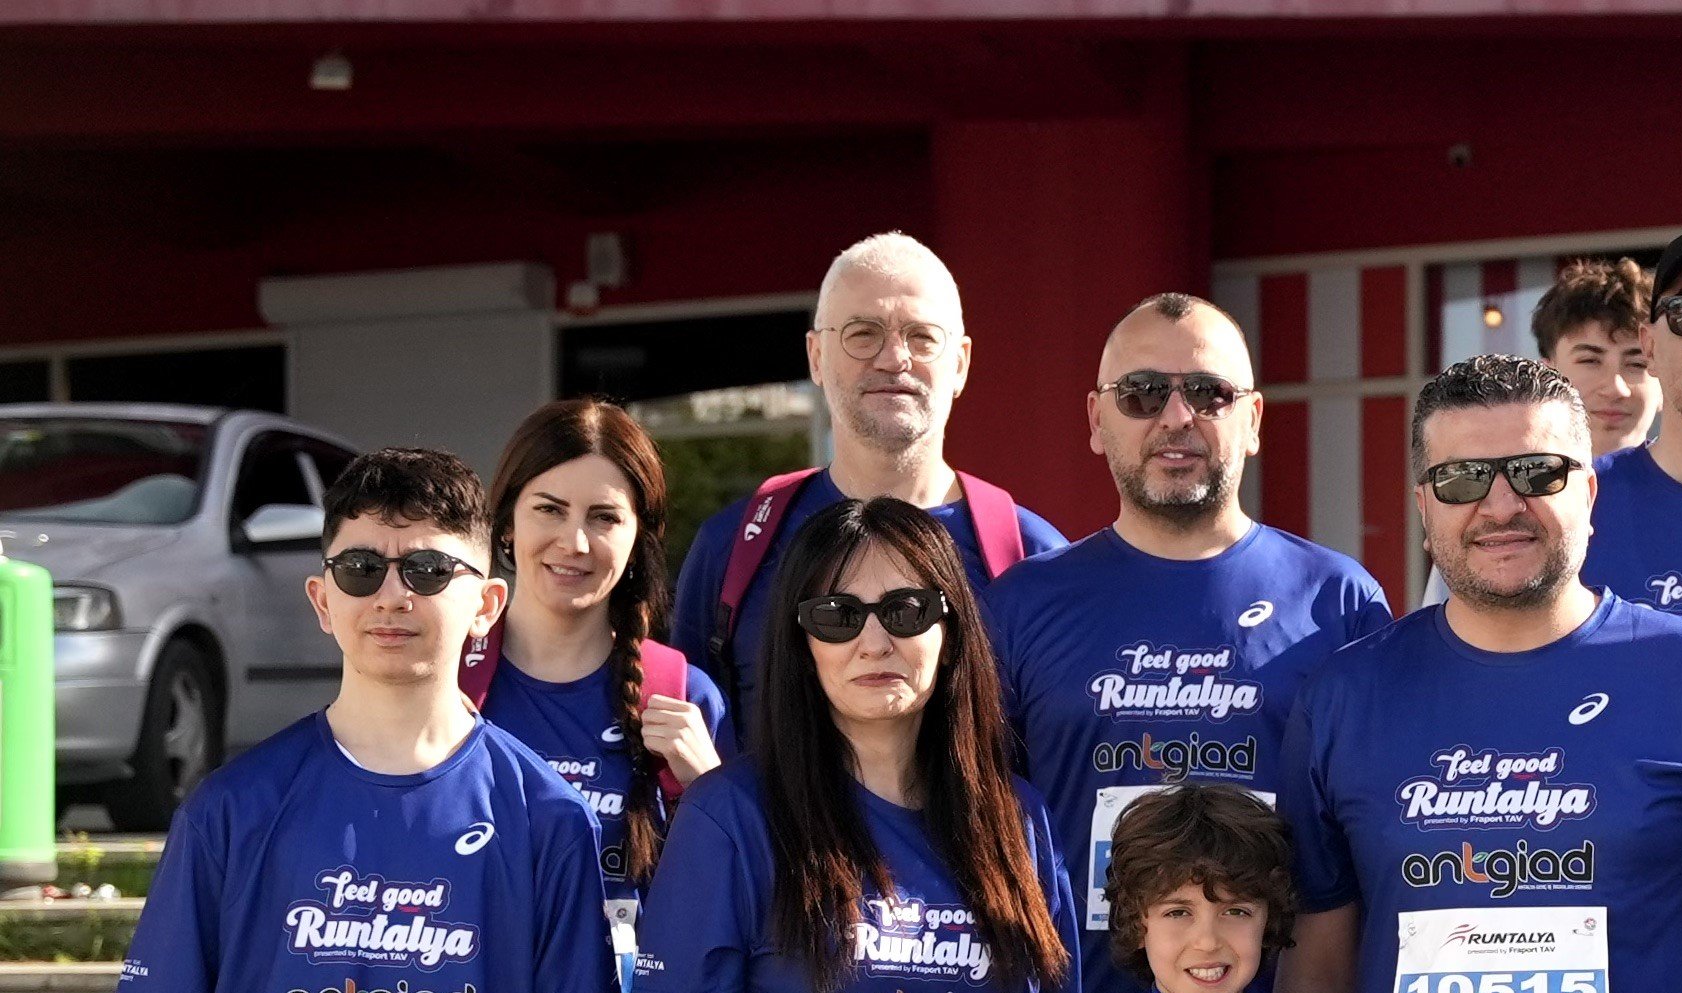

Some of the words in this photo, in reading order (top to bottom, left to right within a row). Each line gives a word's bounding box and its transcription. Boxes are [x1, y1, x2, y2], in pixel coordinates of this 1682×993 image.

[1176, 649, 1230, 675] good
[1091, 674, 1258, 718] Runtalya
[1093, 732, 1257, 782] antgiad
[1496, 753, 1558, 779] good
[1401, 781, 1590, 825] Runtalya
[1470, 815, 1502, 824] Fraport
[1402, 839, 1594, 898] antgiad
[382, 885, 444, 912] good
[286, 906, 474, 966] Runtalya
[1468, 932, 1556, 944] RUNTALYA
[390, 952, 408, 961] TAV
[845, 922, 993, 980] Runtaly
[637, 959, 665, 970] NTALYA
[942, 966, 959, 975] TAV
